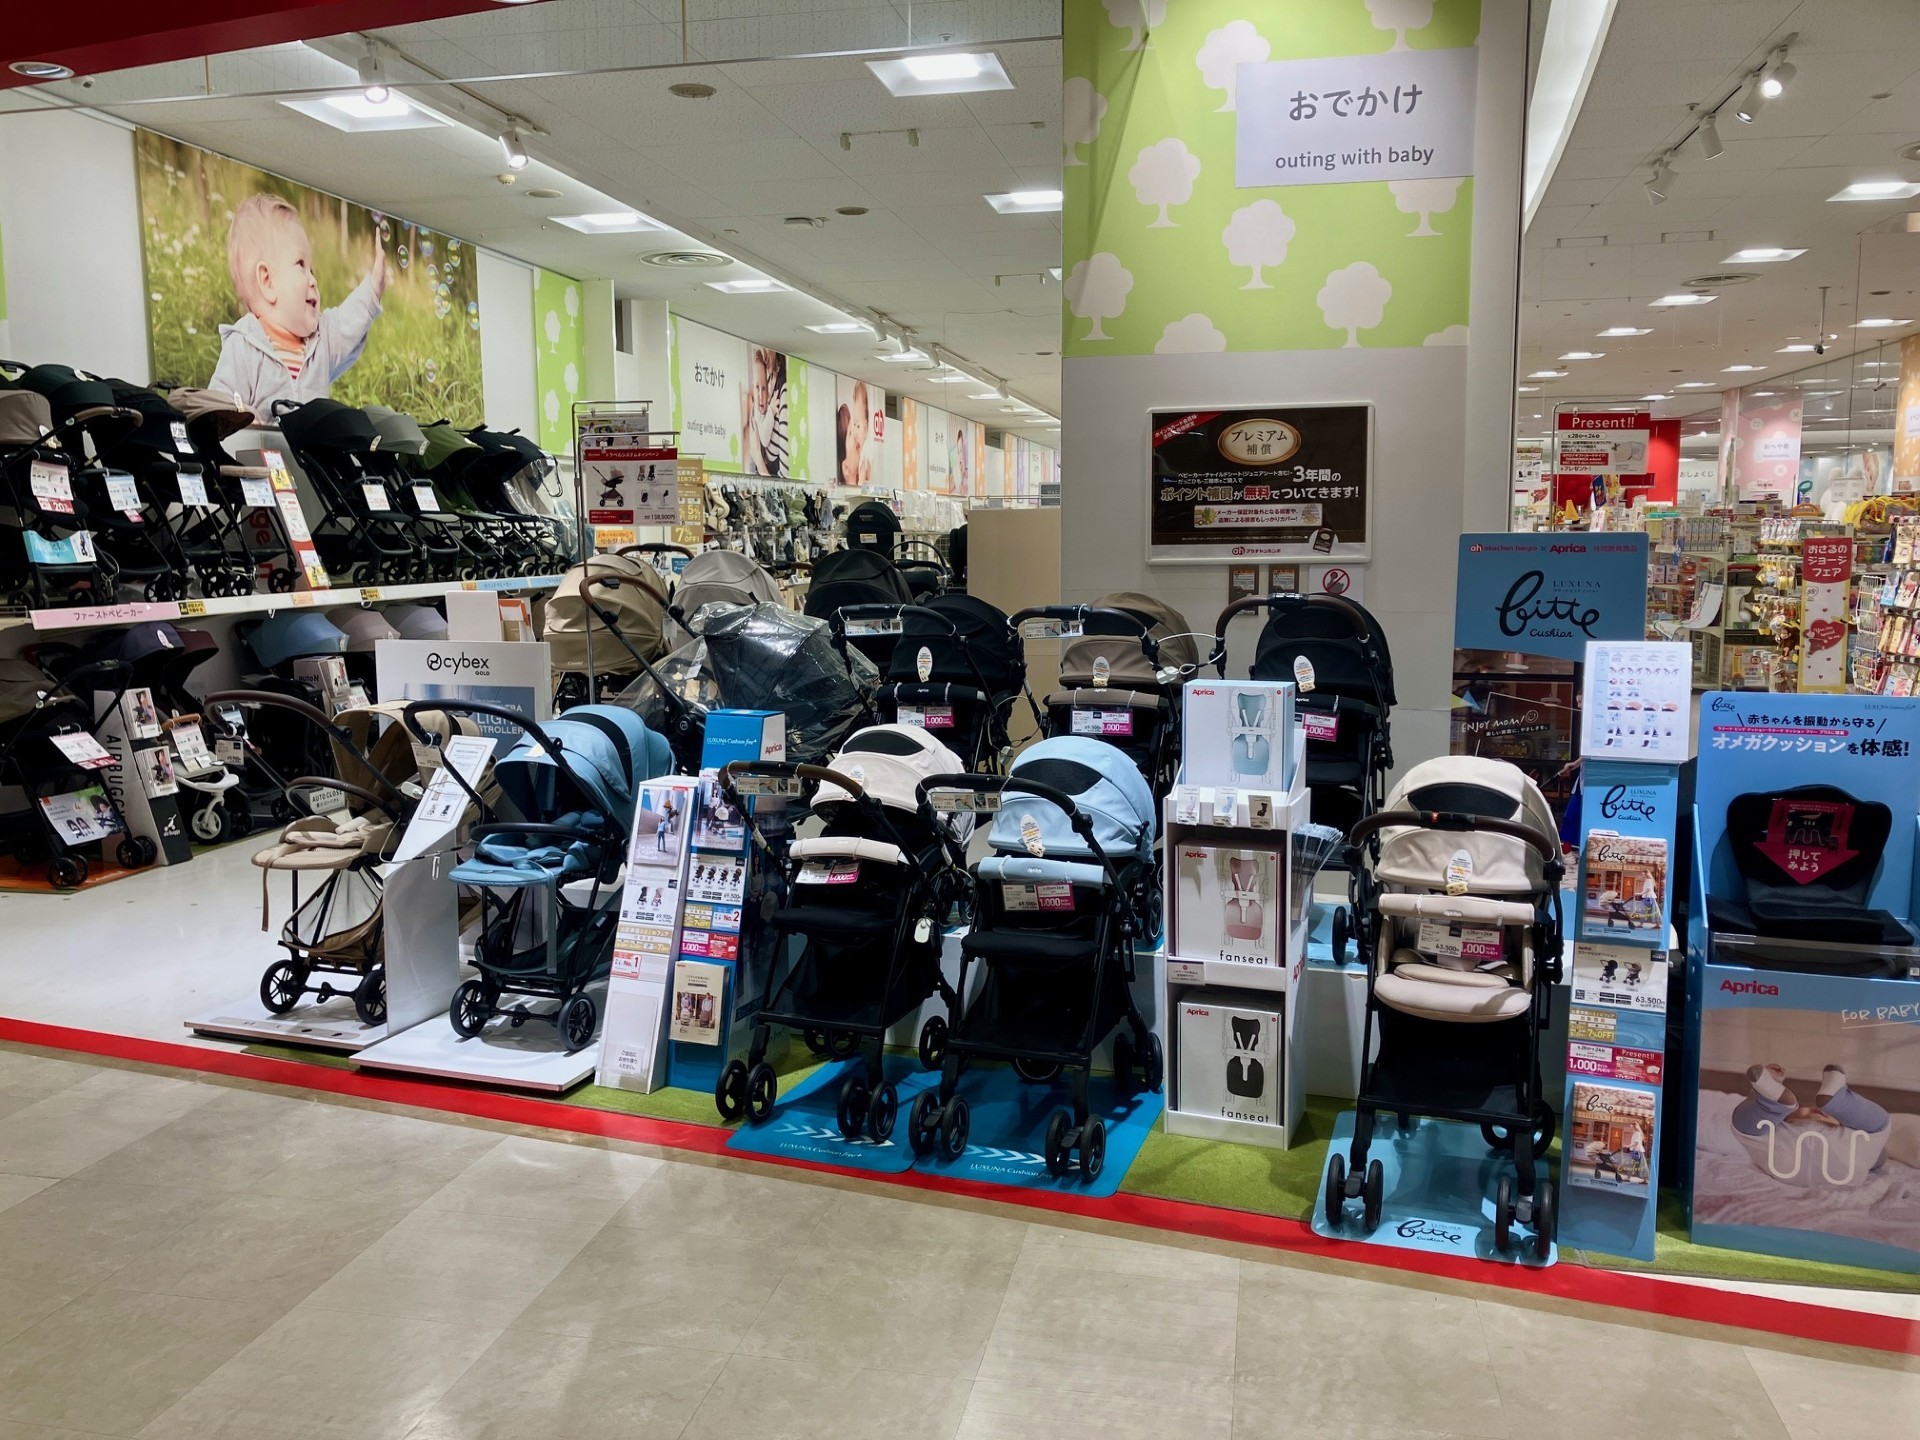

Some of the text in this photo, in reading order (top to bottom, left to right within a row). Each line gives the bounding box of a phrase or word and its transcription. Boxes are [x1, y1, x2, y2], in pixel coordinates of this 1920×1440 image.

[1288, 83, 1423, 121] おでかけ
[1275, 145, 1434, 171] outing with baby
[694, 362, 725, 388] おでかけ
[1572, 417, 1635, 428] Present!!
[1231, 428, 1288, 443] プレミアム
[1246, 443, 1272, 455] 補償
[1292, 465, 1341, 482] 3年間の
[1679, 470, 1714, 478] おしょくじ
[1550, 543, 1587, 554] Aprica
[1807, 544, 1847, 554] おさるの
[1807, 556, 1847, 565] ジョージ
[1812, 568, 1842, 577] フェア
[1553, 580, 1600, 588] LUXUNA
[74, 609, 143, 621] ファーストベビーカー
[444, 652, 490, 675] cybex
[1192, 688, 1215, 696] Aprica
[1747, 714, 1876, 728] 赤ちゃんを振動から守る
[1462, 721, 1490, 733] ENJOY
[765, 743, 783, 754] Aprica
[1712, 733, 1909, 757] オメガクッションを体感!
[1630, 788, 1656, 796] LUXUNA
[312, 793, 326, 803] AUTO
[1184, 851, 1207, 859] Aprica
[1787, 849, 1821, 861] 押して
[1787, 861, 1819, 872] みよう
[1039, 898, 1060, 907] 1,000
[733, 911, 740, 922] 2
[682, 942, 699, 952] 1,000
[634, 957, 639, 968] 1
[1219, 949, 1268, 965] fanseat
[1720, 979, 1779, 996] Aprica
[1186, 1008, 1209, 1016] Aprica
[1841, 1002, 1920, 1022] FOR BABY
[1621, 1049, 1655, 1059] Present!!
[1569, 1058, 1597, 1071] 1,000
[1221, 1106, 1269, 1123] fanseat
[779, 1142, 812, 1152] LUXUNA
[812, 1146, 841, 1156] Cushion
[970, 1163, 1038, 1177] LUXUNA Cushion
